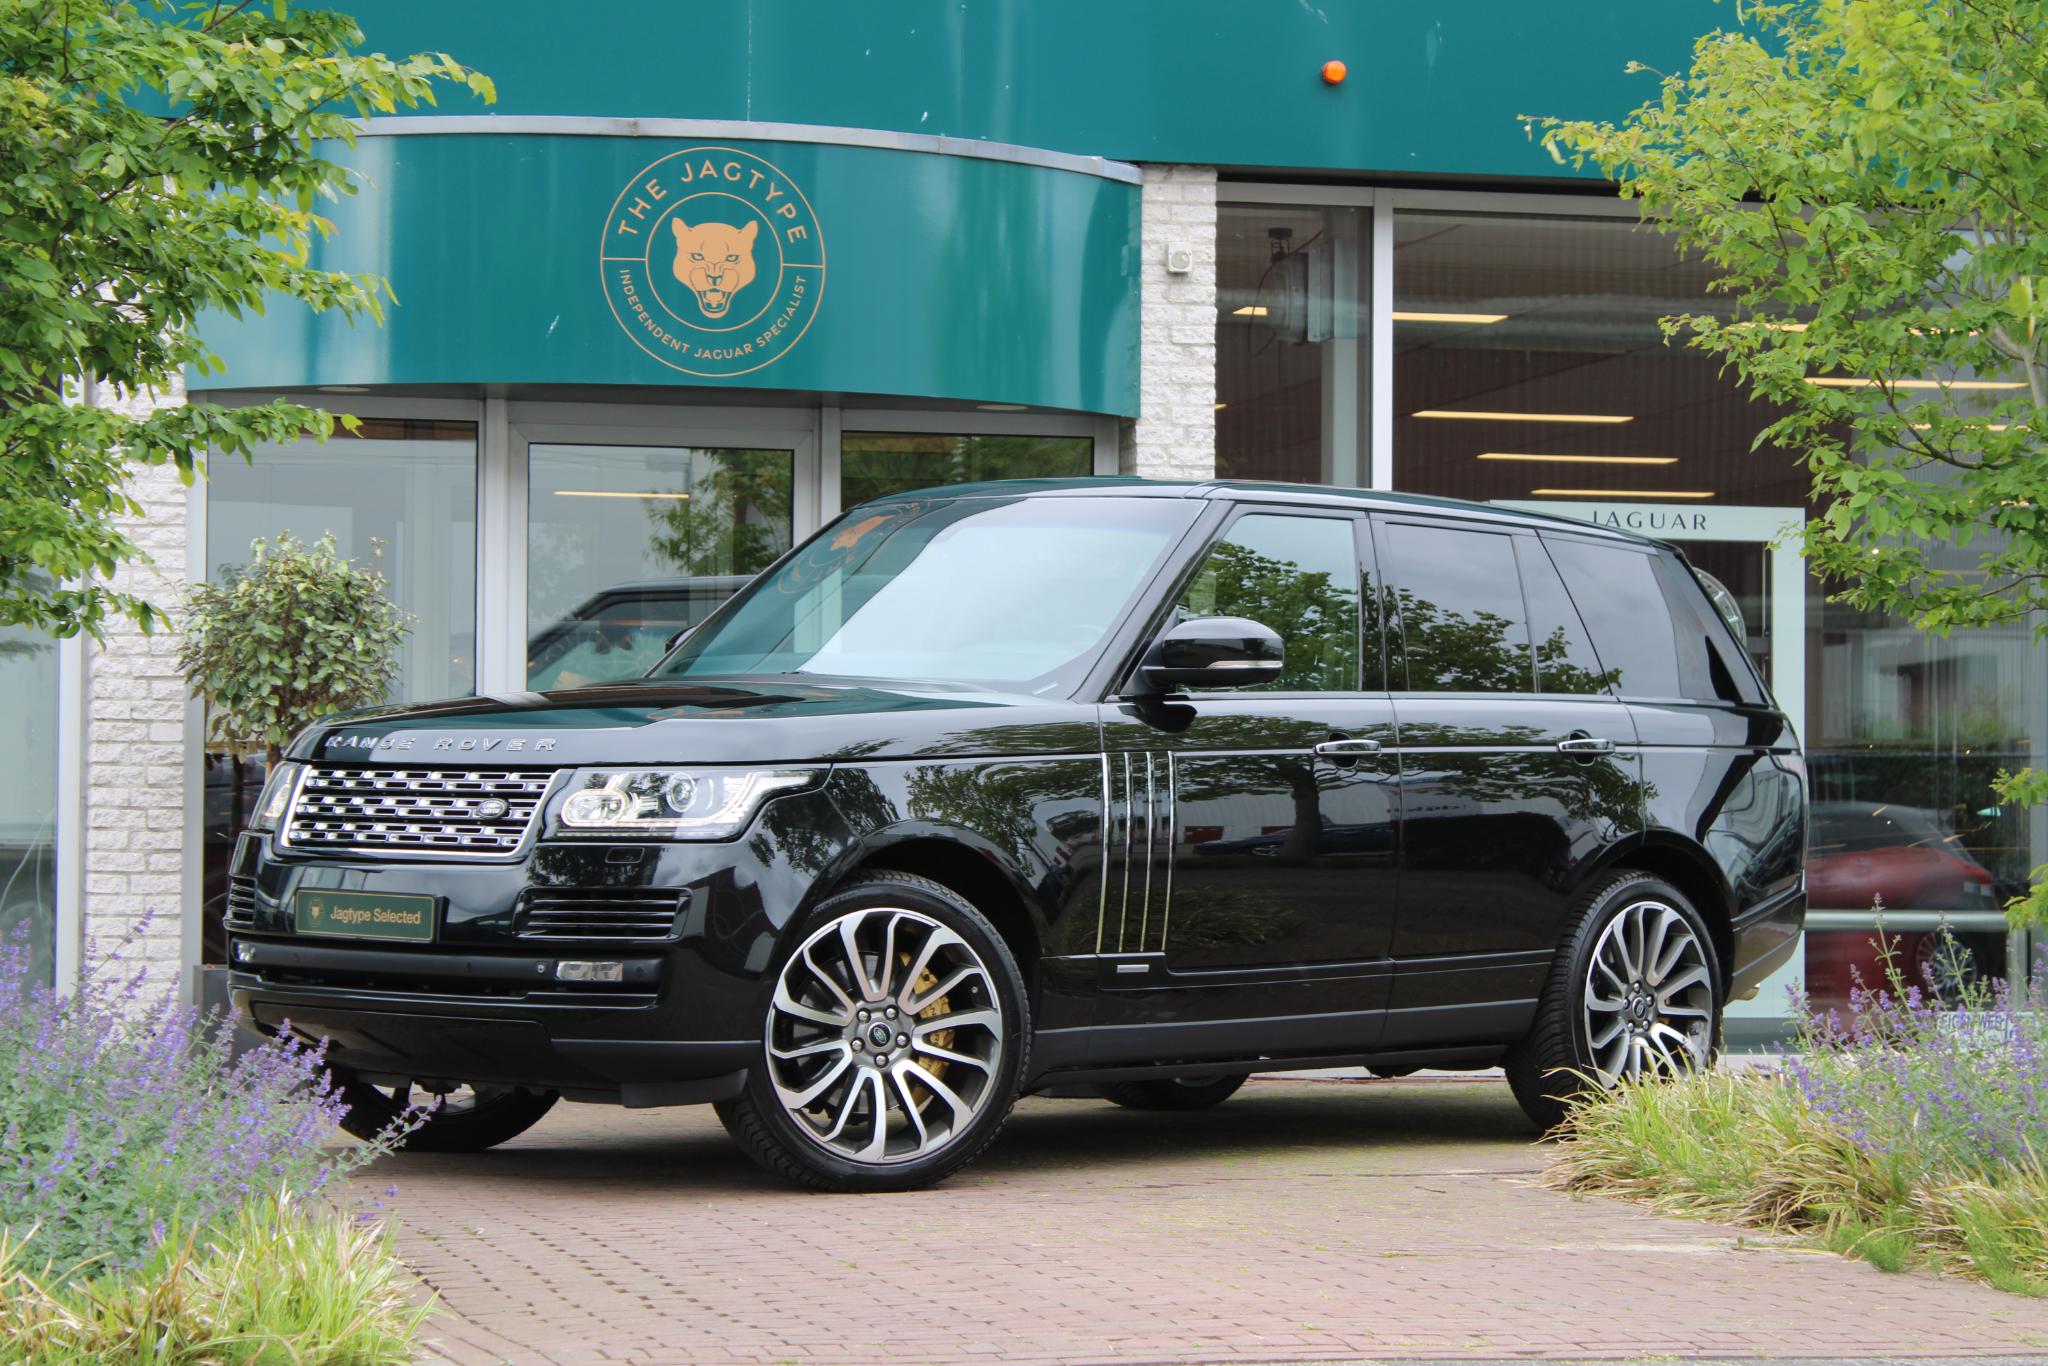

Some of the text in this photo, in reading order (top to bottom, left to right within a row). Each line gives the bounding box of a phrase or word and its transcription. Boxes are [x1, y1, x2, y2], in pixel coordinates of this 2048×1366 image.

[618, 159, 808, 244] THE JAGTYPE
[619, 268, 807, 360] INDEPENDENT JAGUAR SPECIALIST
[324, 734, 556, 752] RANGE ROVER
[330, 906, 421, 924] Jagtype Selected
